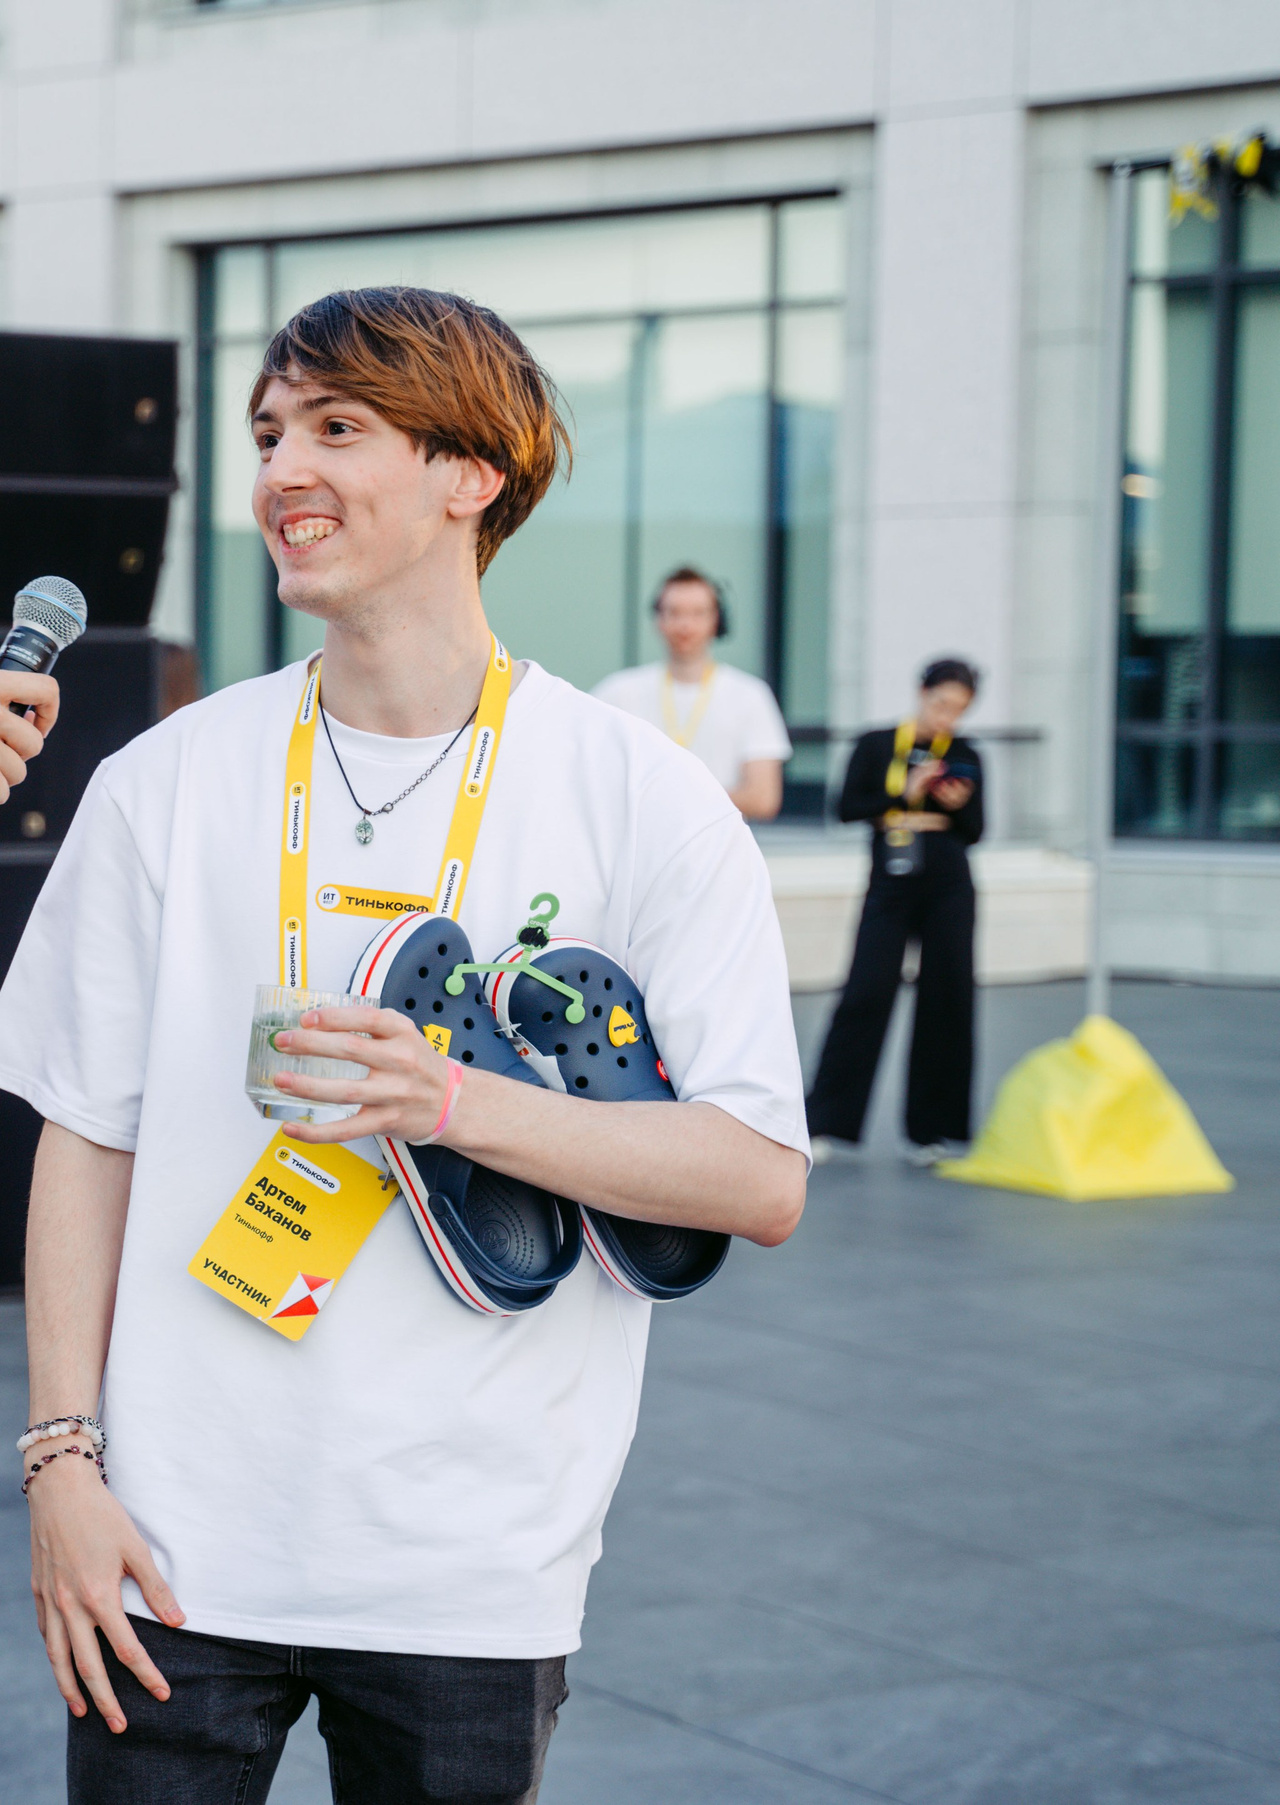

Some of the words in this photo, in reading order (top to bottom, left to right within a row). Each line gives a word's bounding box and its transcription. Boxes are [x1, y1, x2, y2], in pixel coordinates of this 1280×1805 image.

[473, 731, 489, 780] ТИНЬКОФФ
[292, 799, 300, 849] ТИНЬКОФФ
[323, 892, 335, 900] ИТ
[345, 896, 429, 913] ТИНЬКОФФ
[441, 863, 458, 914] ТИНЬКОФФ
[255, 1176, 308, 1215] Артем
[291, 1158, 336, 1189] ТИНЬКОФФ
[234, 1213, 274, 1243] Тинькофф
[244, 1192, 313, 1242] Баханов
[203, 1257, 272, 1308] УЧАСТНИК
